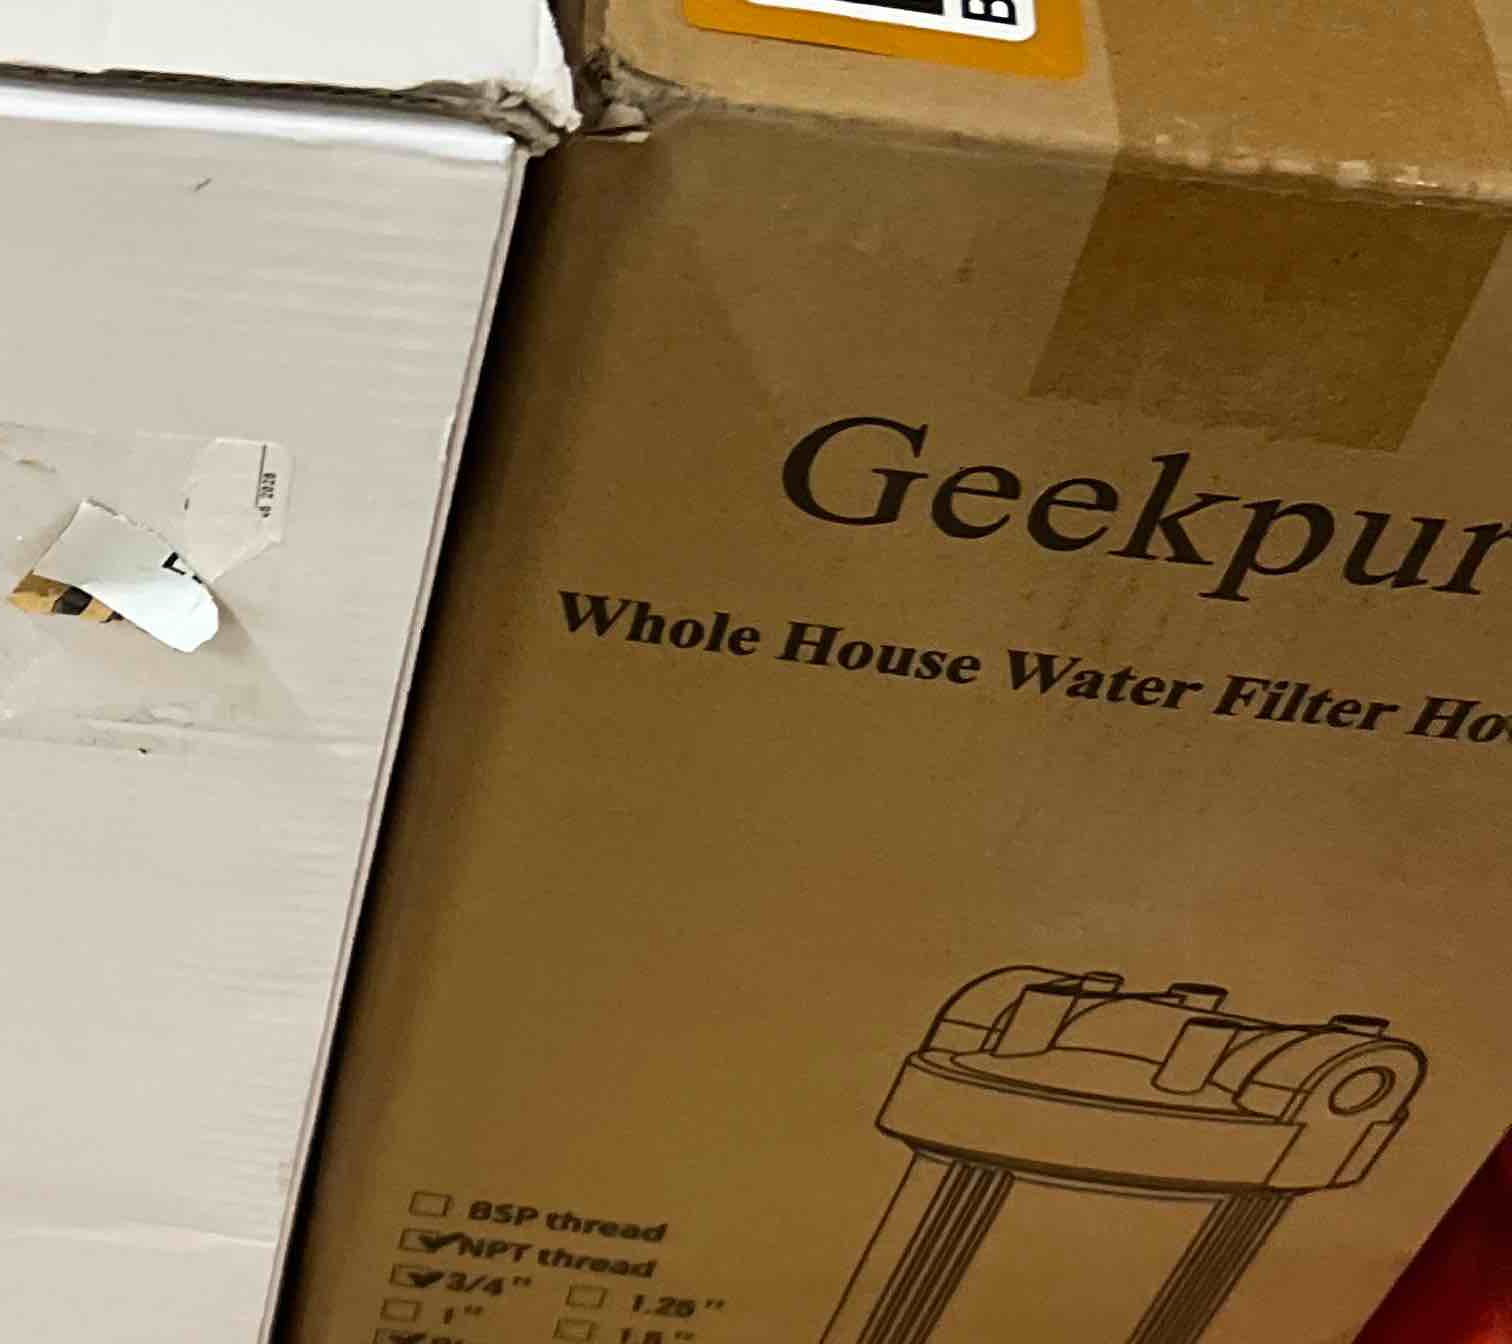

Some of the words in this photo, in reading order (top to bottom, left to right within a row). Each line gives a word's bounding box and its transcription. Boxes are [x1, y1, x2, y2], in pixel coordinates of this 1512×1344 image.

[557, 590, 761, 656] Whole
[776, 620, 982, 685] House
[1006, 648, 1203, 711] Water
[1212, 674, 1400, 731] Filter
[1403, 696, 1512, 743] Ho
[468, 1200, 539, 1226] BSP
[545, 1210, 669, 1244] thread
[456, 1233, 533, 1264] NPT
[536, 1246, 660, 1280] thread
